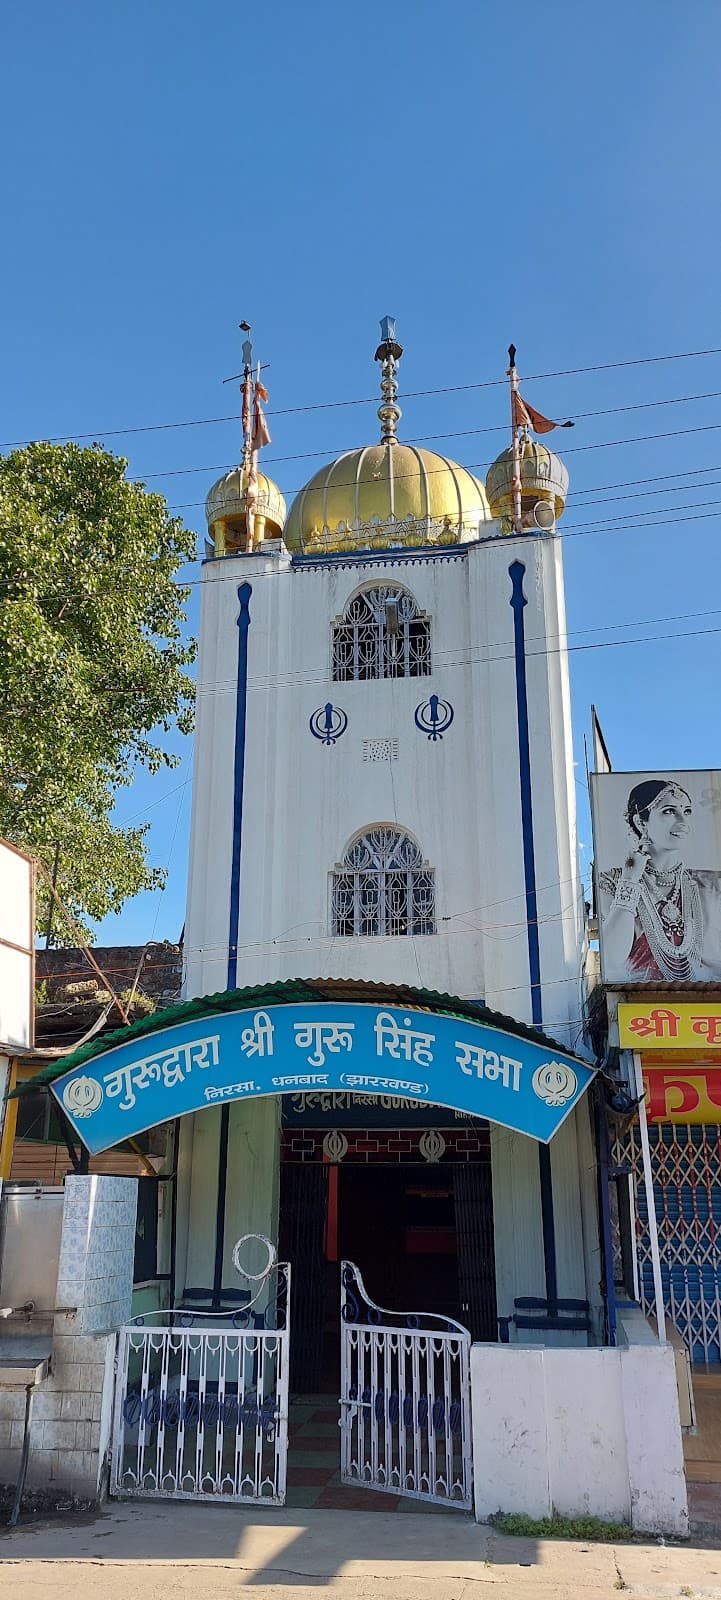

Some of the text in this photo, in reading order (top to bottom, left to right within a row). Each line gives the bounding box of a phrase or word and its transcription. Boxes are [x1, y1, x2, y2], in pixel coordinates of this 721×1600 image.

[628, 1009, 680, 1038] श्री
[103, 1011, 523, 1110] गुरूद्वारा श्री गुरू सिंह सभा
[271, 1073, 329, 1087] धनबाद
[339, 1072, 429, 1095] (झारखण्ड)
